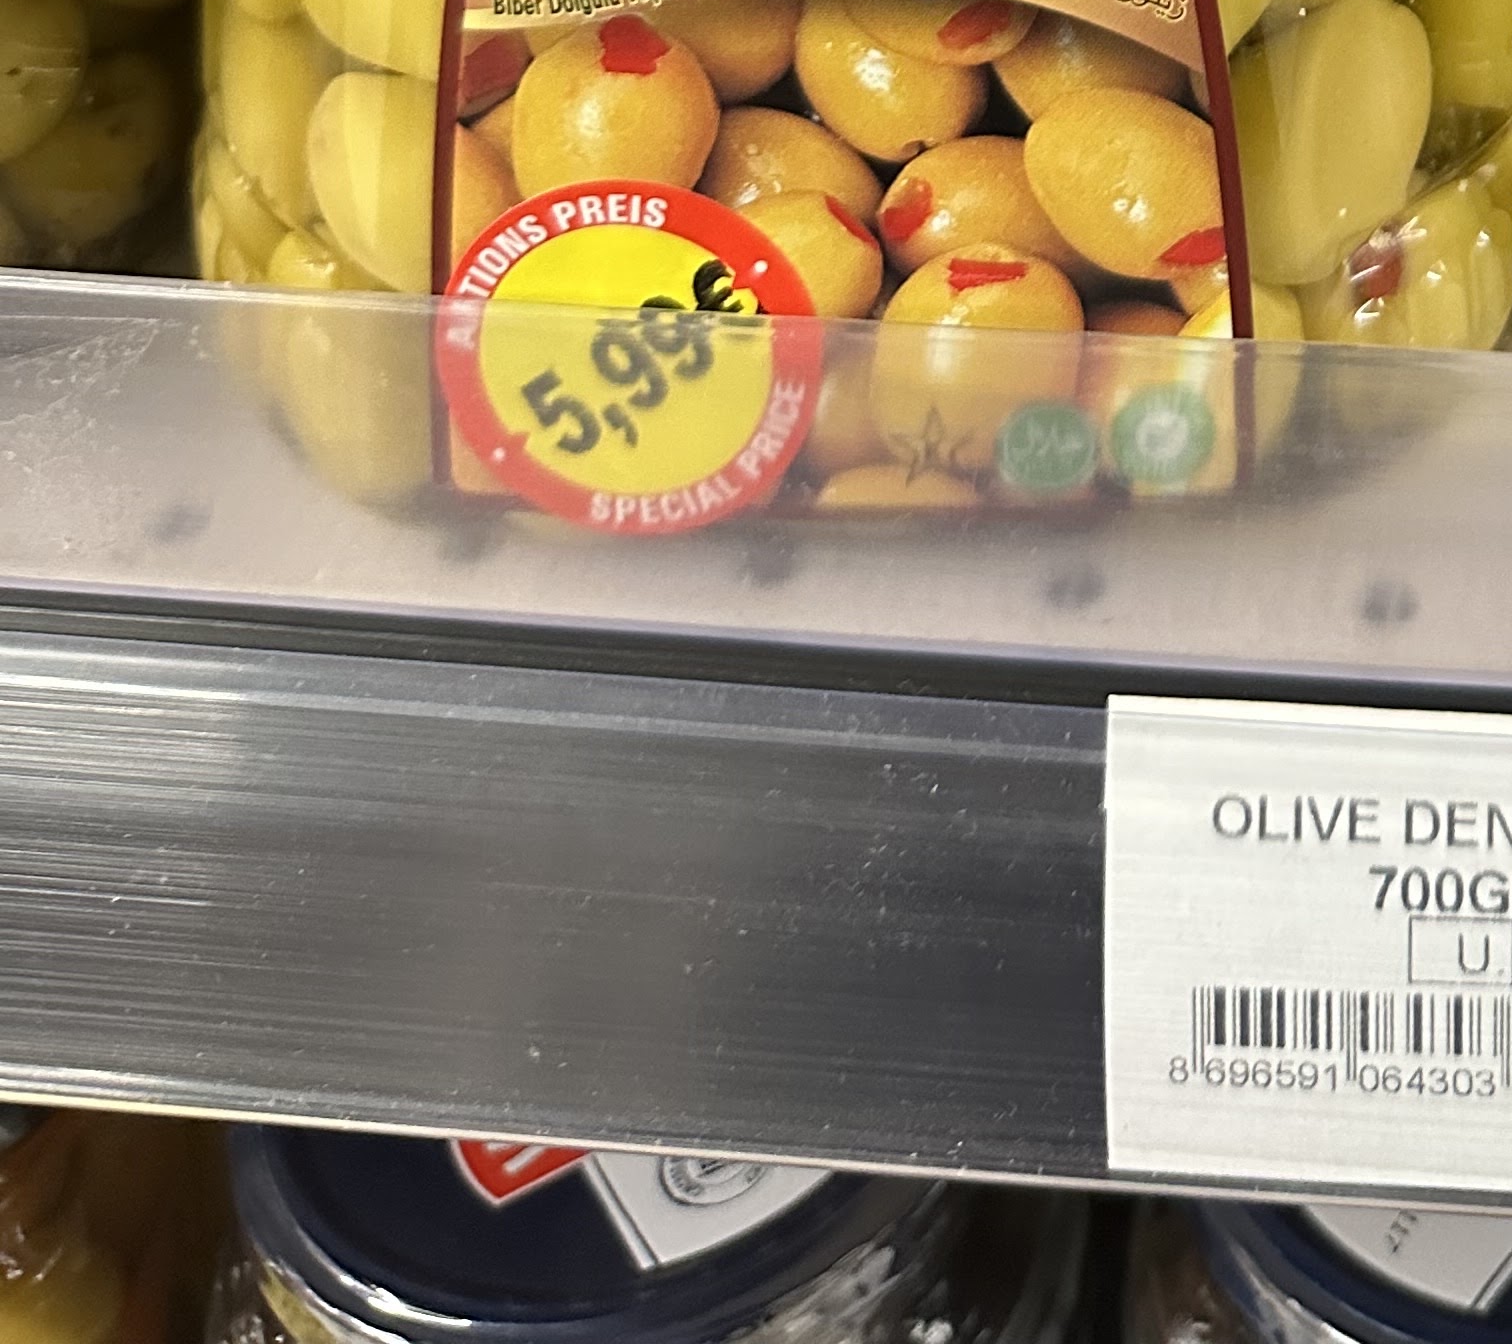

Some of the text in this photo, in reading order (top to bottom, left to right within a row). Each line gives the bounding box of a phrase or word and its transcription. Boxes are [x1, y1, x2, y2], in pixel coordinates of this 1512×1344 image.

[551, 194, 669, 232] PREIS
[589, 378, 804, 526] SPECIAL PRICE
[1212, 794, 1380, 844] OLIVE
